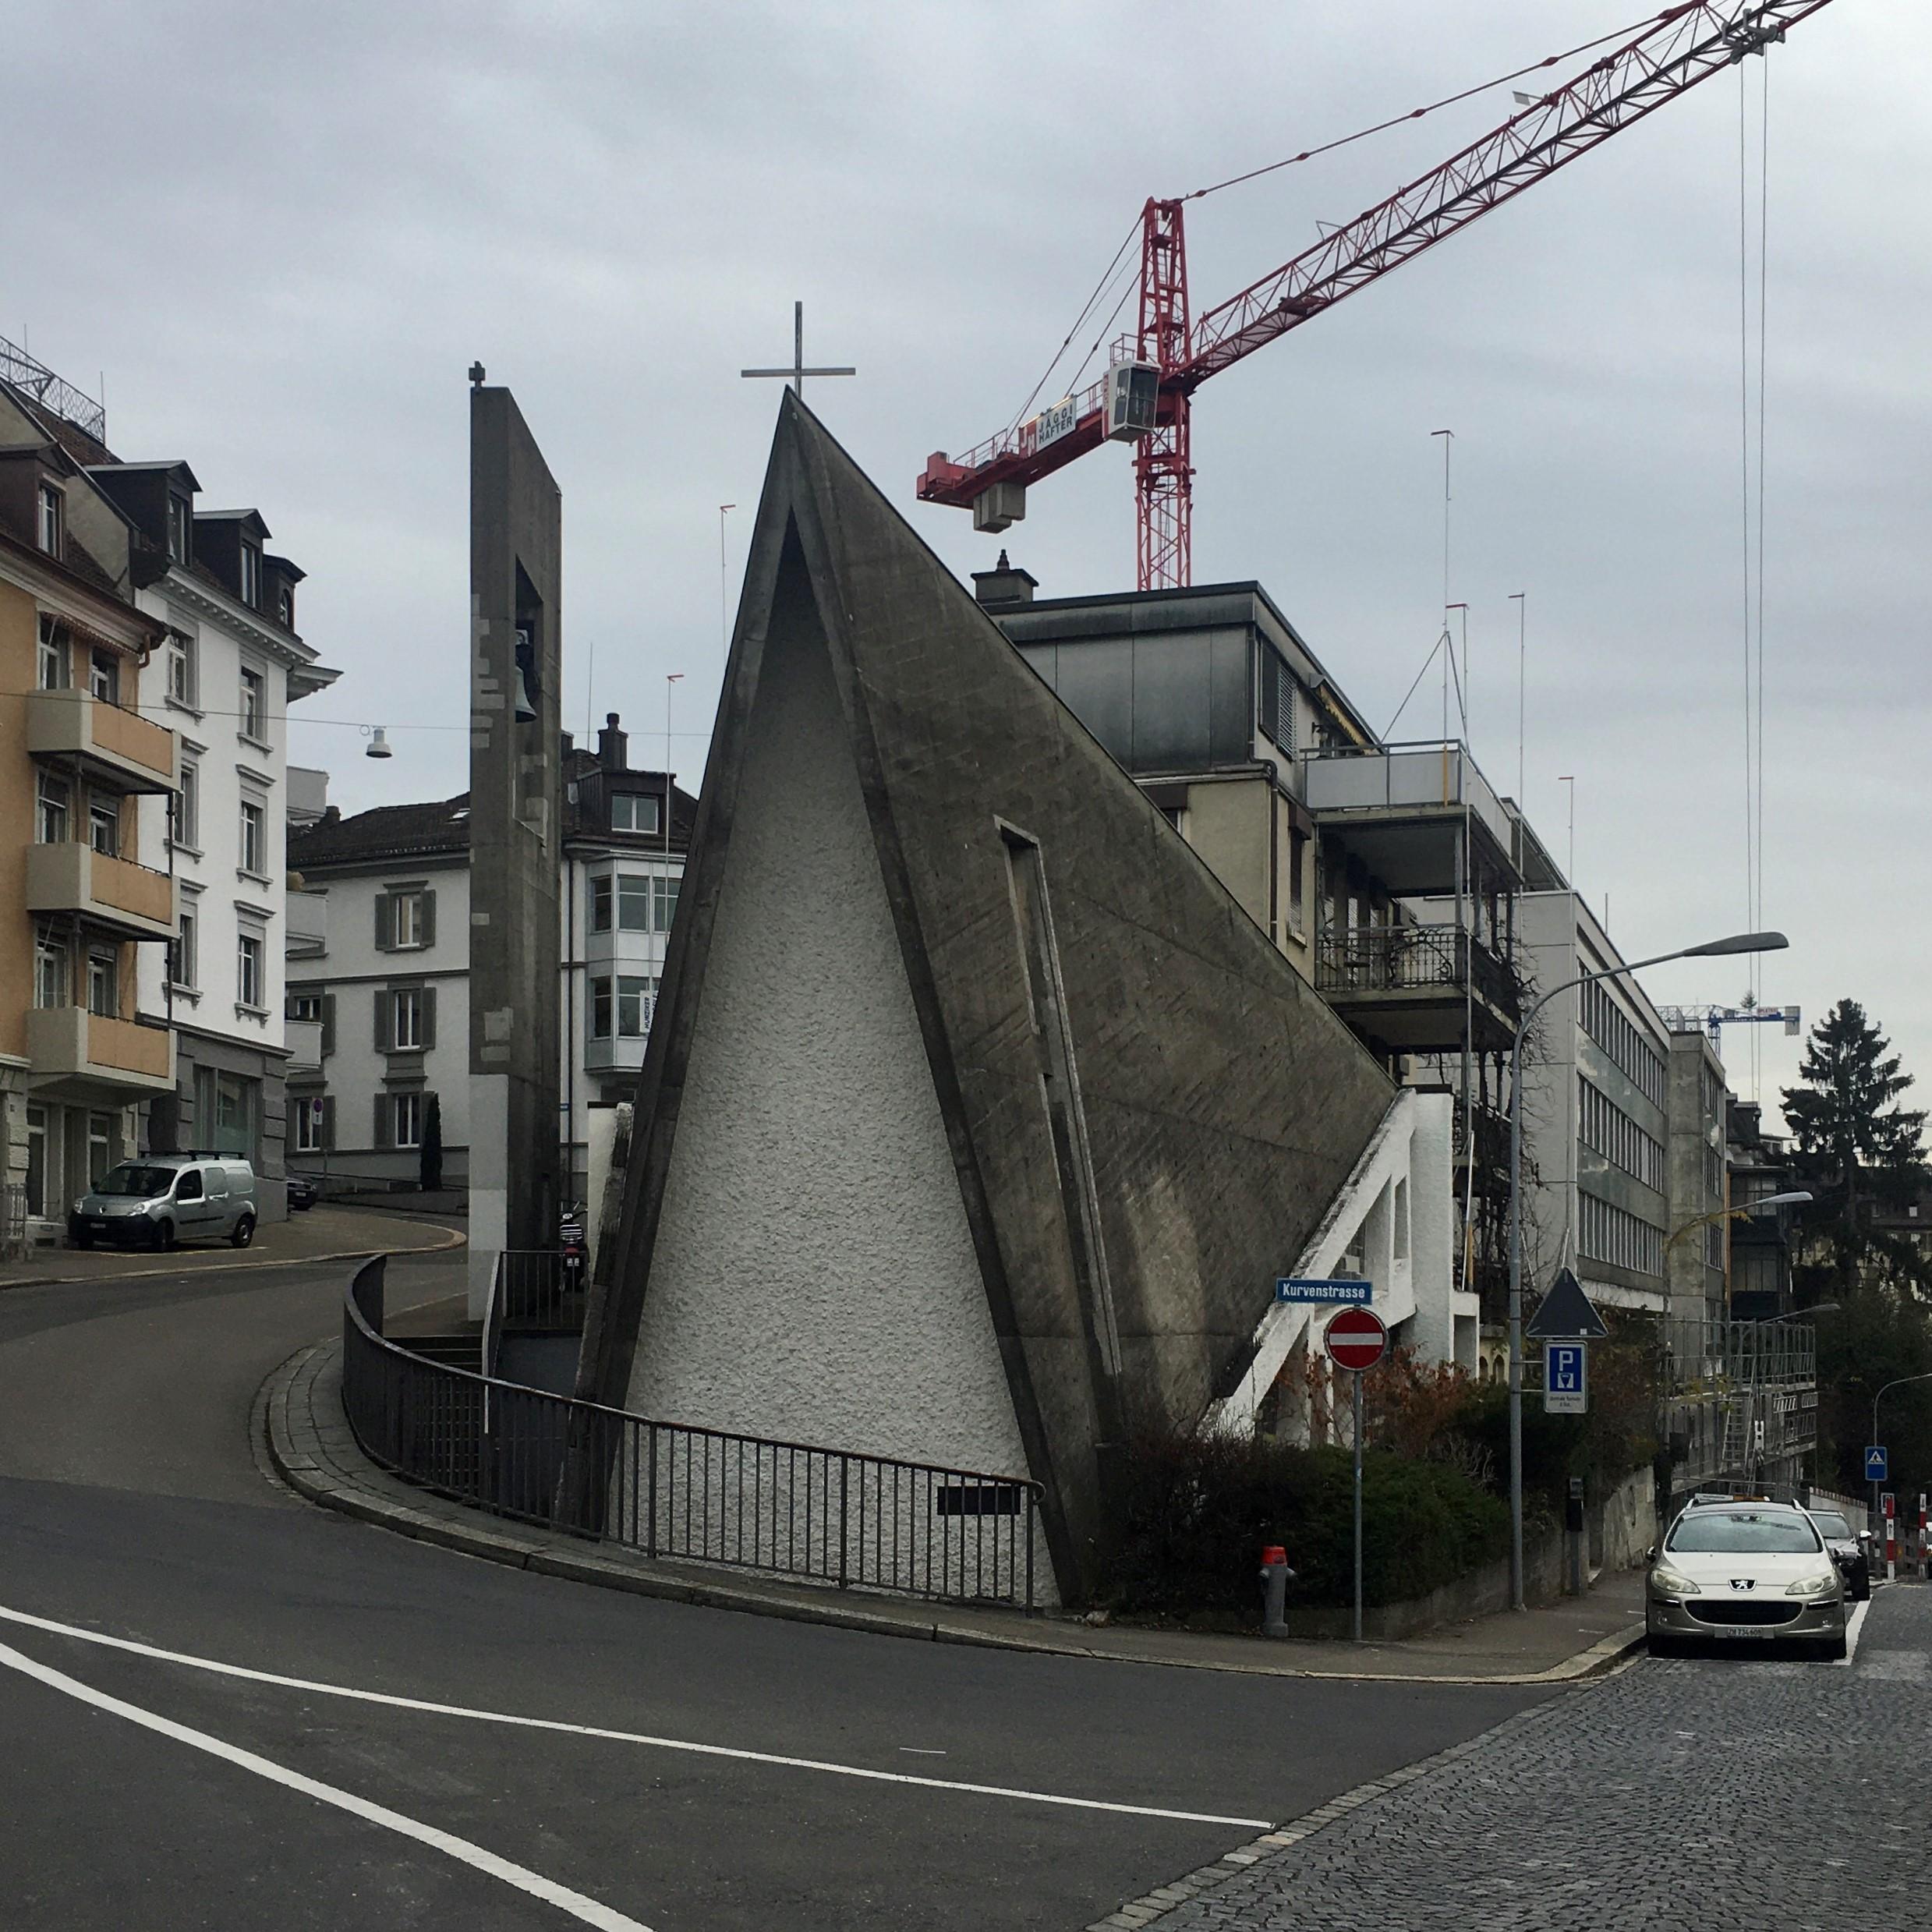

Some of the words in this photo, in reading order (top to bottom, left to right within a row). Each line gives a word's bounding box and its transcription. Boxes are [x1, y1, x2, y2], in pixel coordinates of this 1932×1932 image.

[1039, 416, 1073, 444] HAFTER
[1283, 1283, 1365, 1299] Kurvenstrasse
[1559, 1350, 1573, 1372] P
